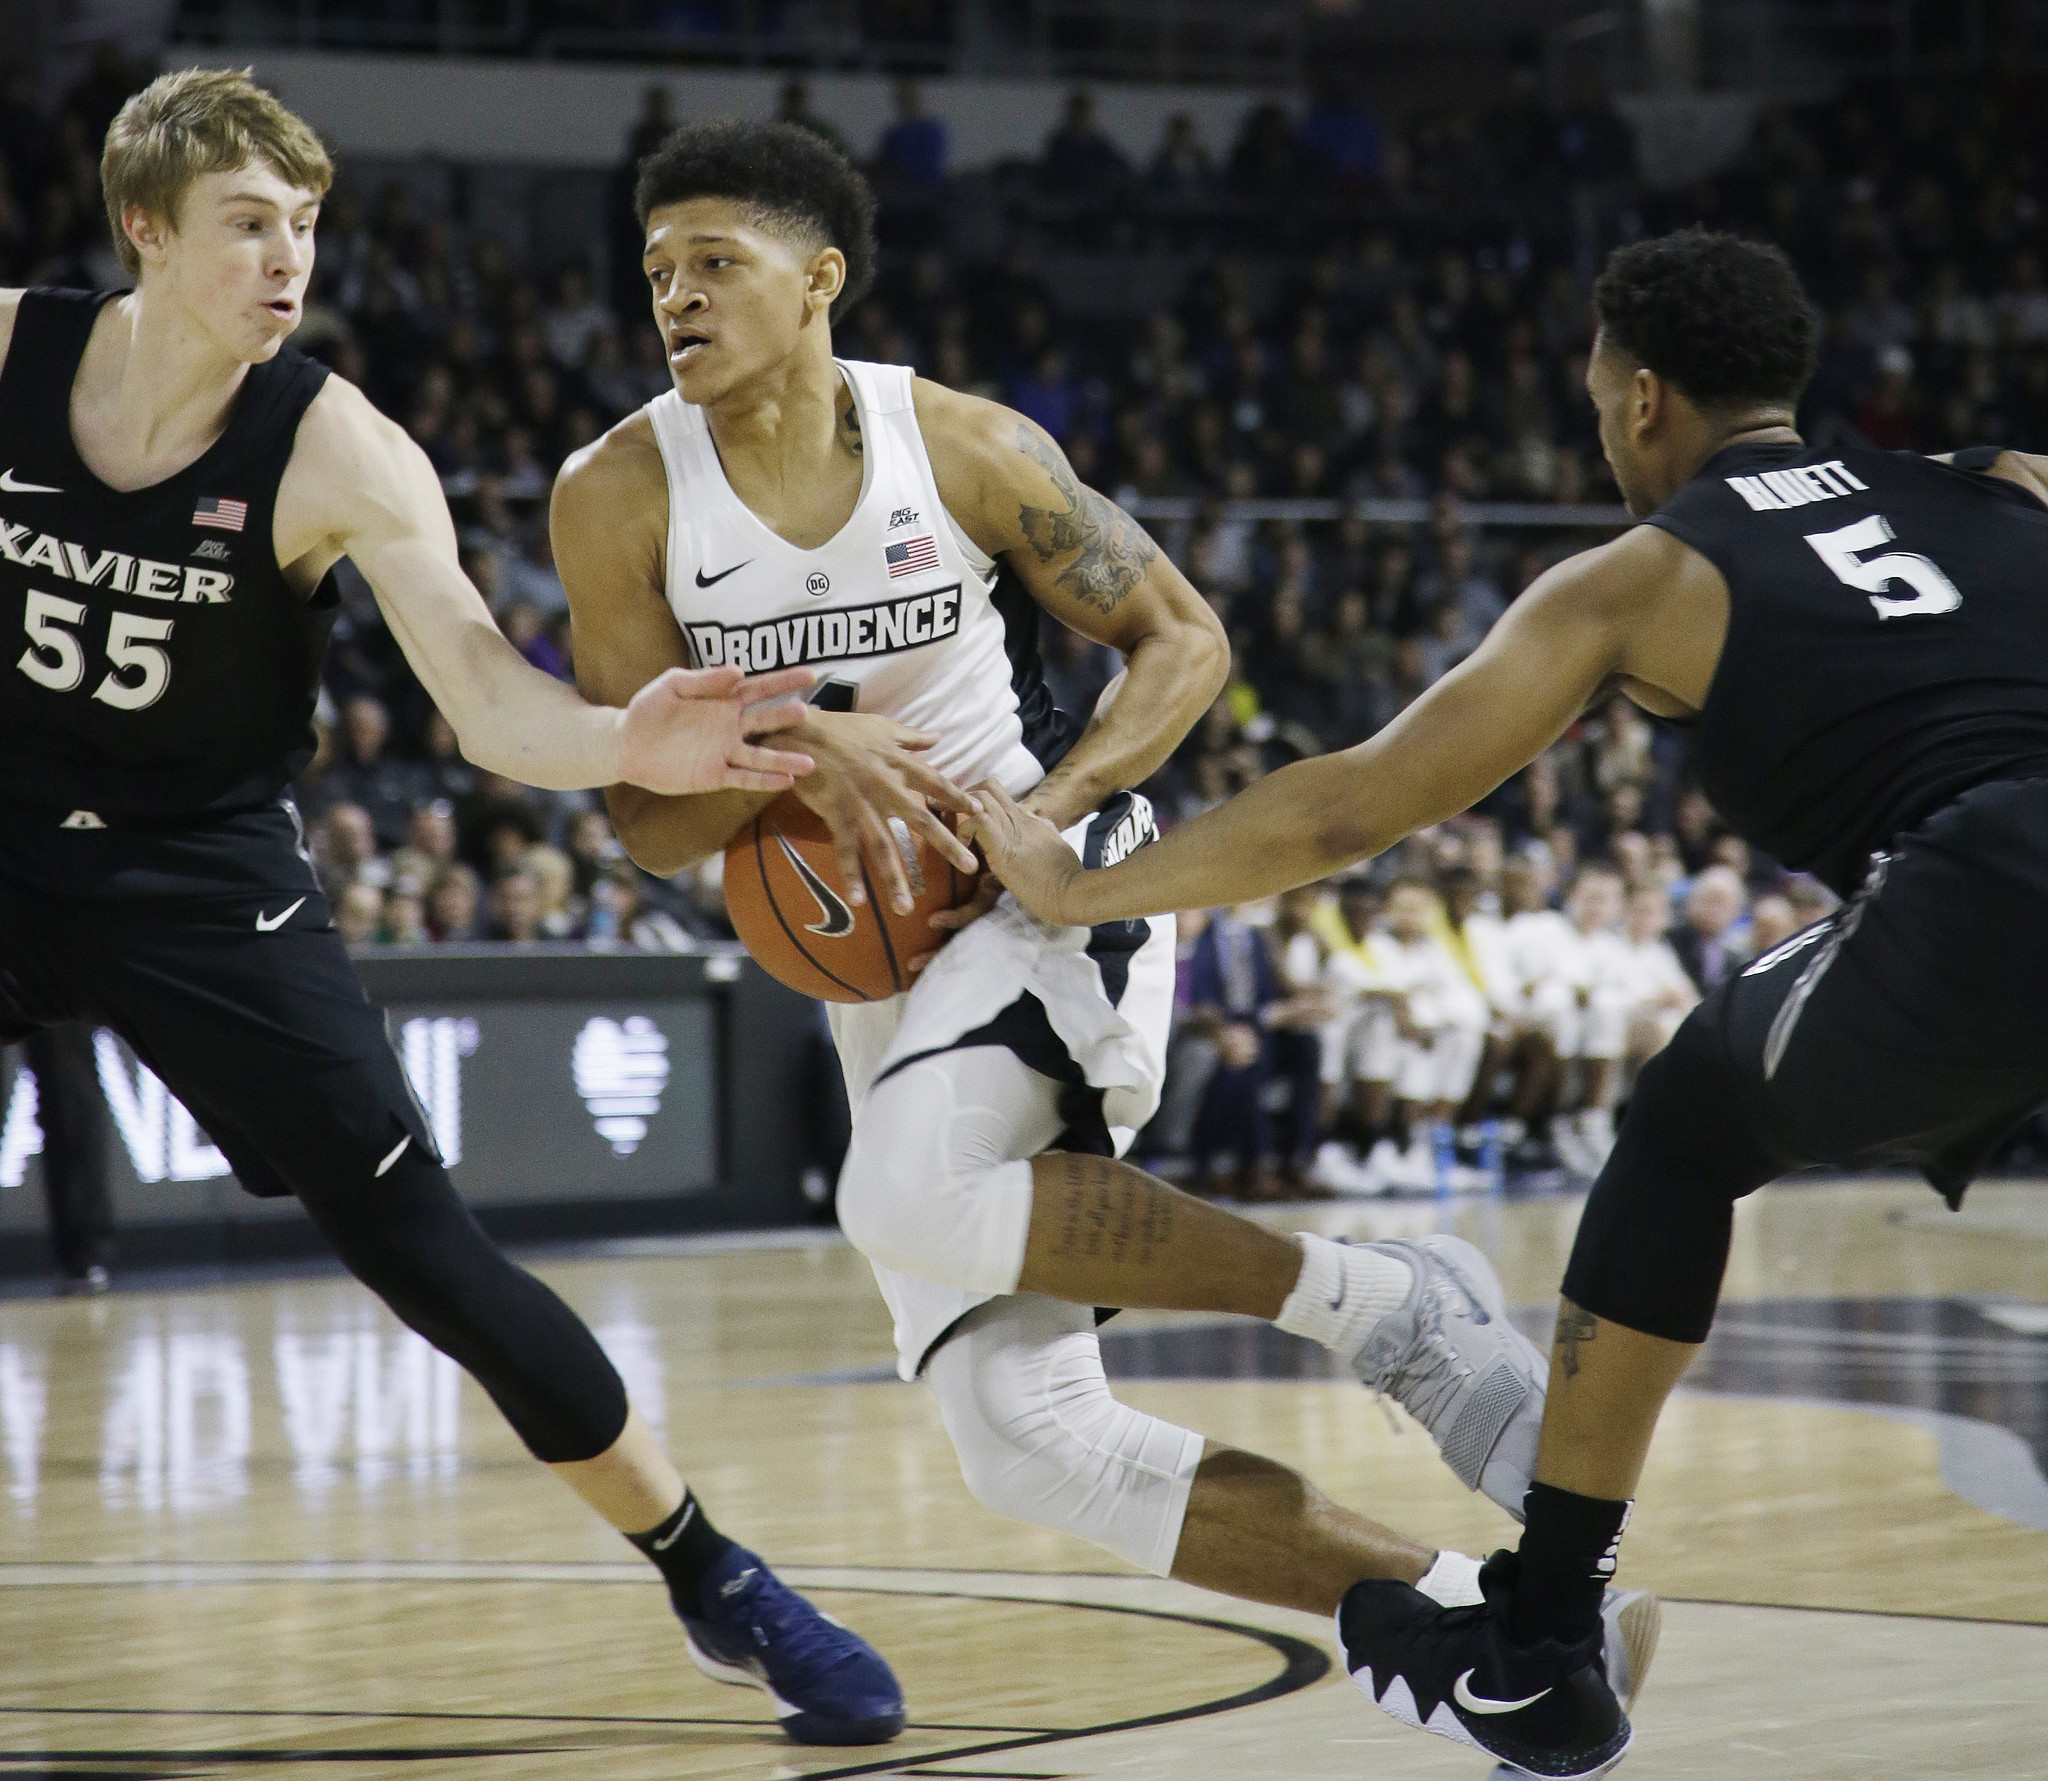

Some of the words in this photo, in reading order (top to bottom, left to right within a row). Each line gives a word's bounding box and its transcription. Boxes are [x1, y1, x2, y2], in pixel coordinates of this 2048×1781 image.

[889, 512, 920, 527] EAST
[891, 507, 912, 518] BIG
[1724, 460, 1870, 511] BLUETT
[0, 517, 235, 604] XAVIER
[1802, 514, 1963, 621] 5
[16, 588, 175, 712] 55
[689, 588, 960, 675] PROVIDENCE
